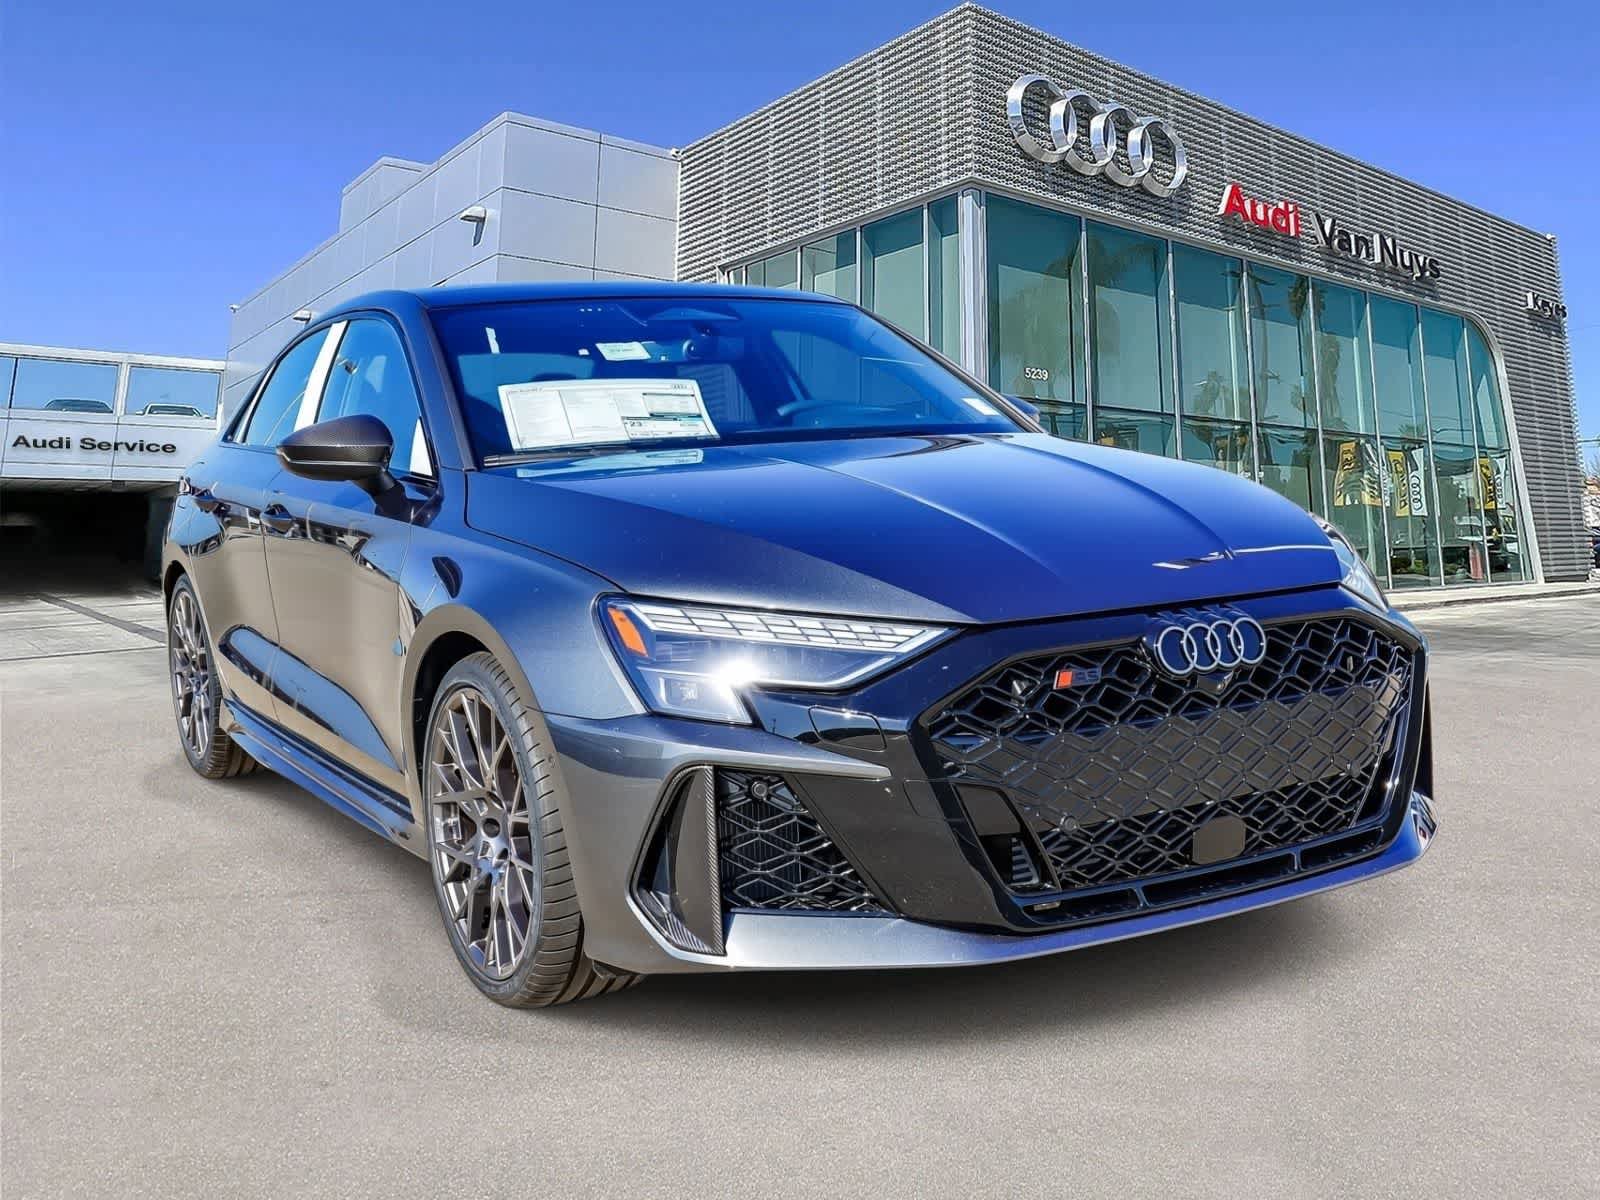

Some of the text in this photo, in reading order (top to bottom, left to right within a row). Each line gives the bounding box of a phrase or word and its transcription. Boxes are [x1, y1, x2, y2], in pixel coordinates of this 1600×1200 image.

[1218, 182, 1441, 280] Audi Van Nuys
[1024, 367, 1049, 381] 5239
[12, 435, 177, 453] Audi Service
